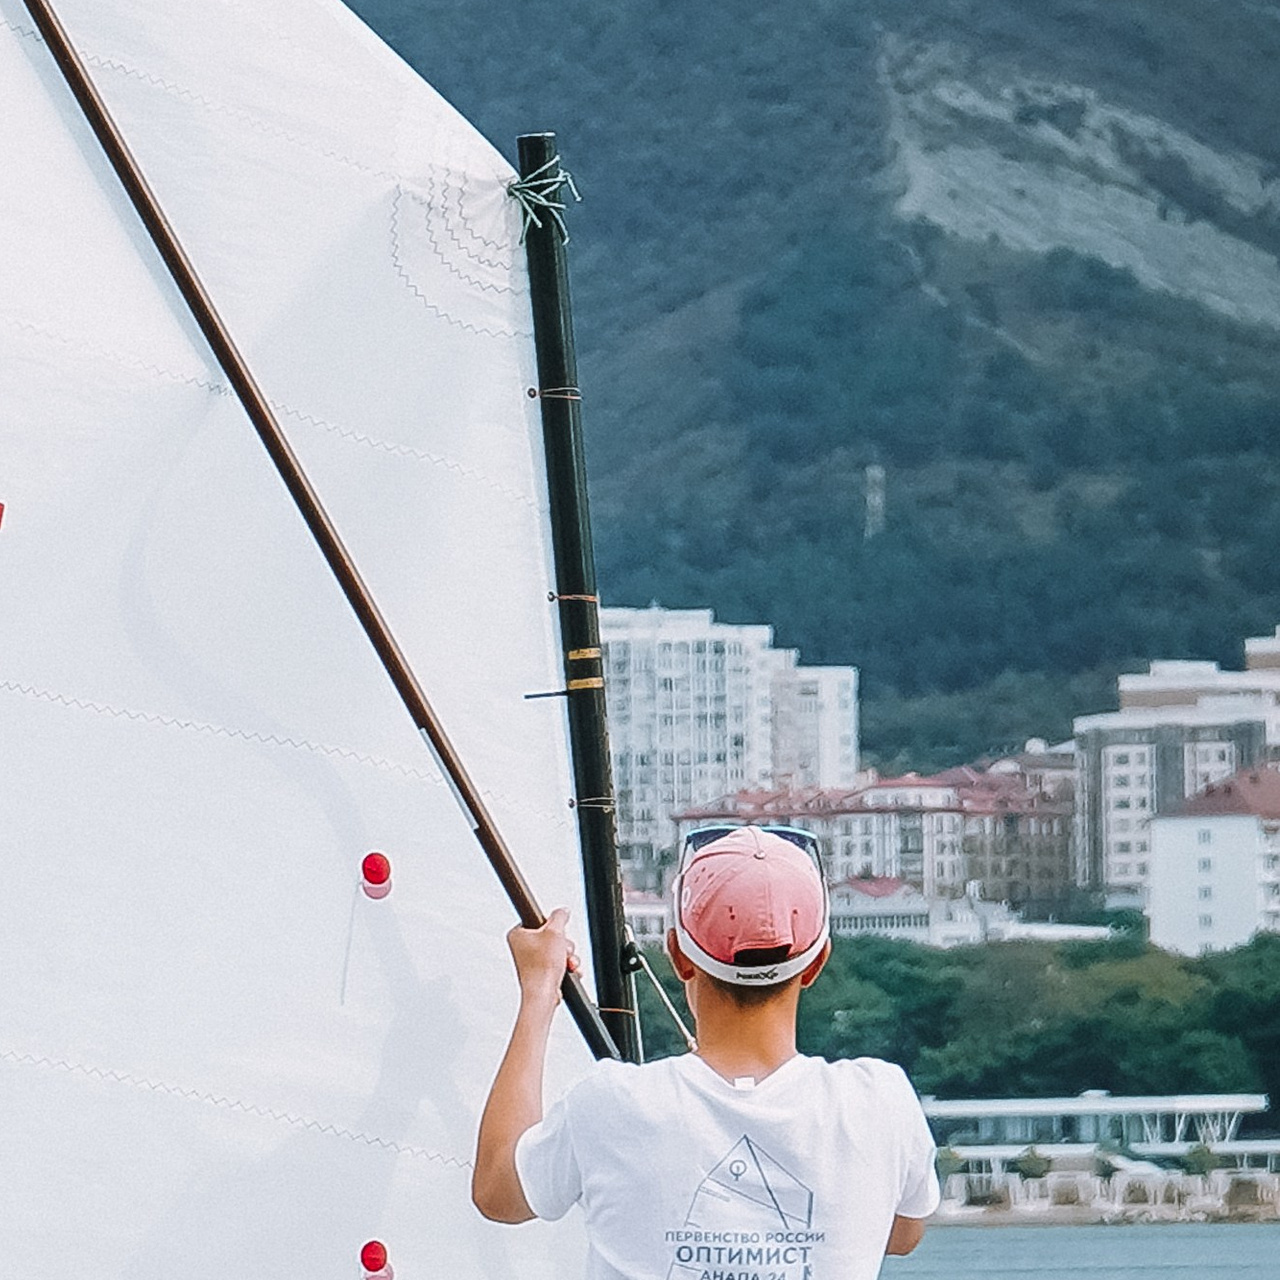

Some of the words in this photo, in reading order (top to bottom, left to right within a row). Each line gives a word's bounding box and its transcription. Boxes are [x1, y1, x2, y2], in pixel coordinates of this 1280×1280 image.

[664, 1230, 760, 1245] ПЕРВЕНСТВО
[765, 1230, 826, 1244] РОССИИ
[676, 1245, 813, 1266] ОПТИМИСТ
